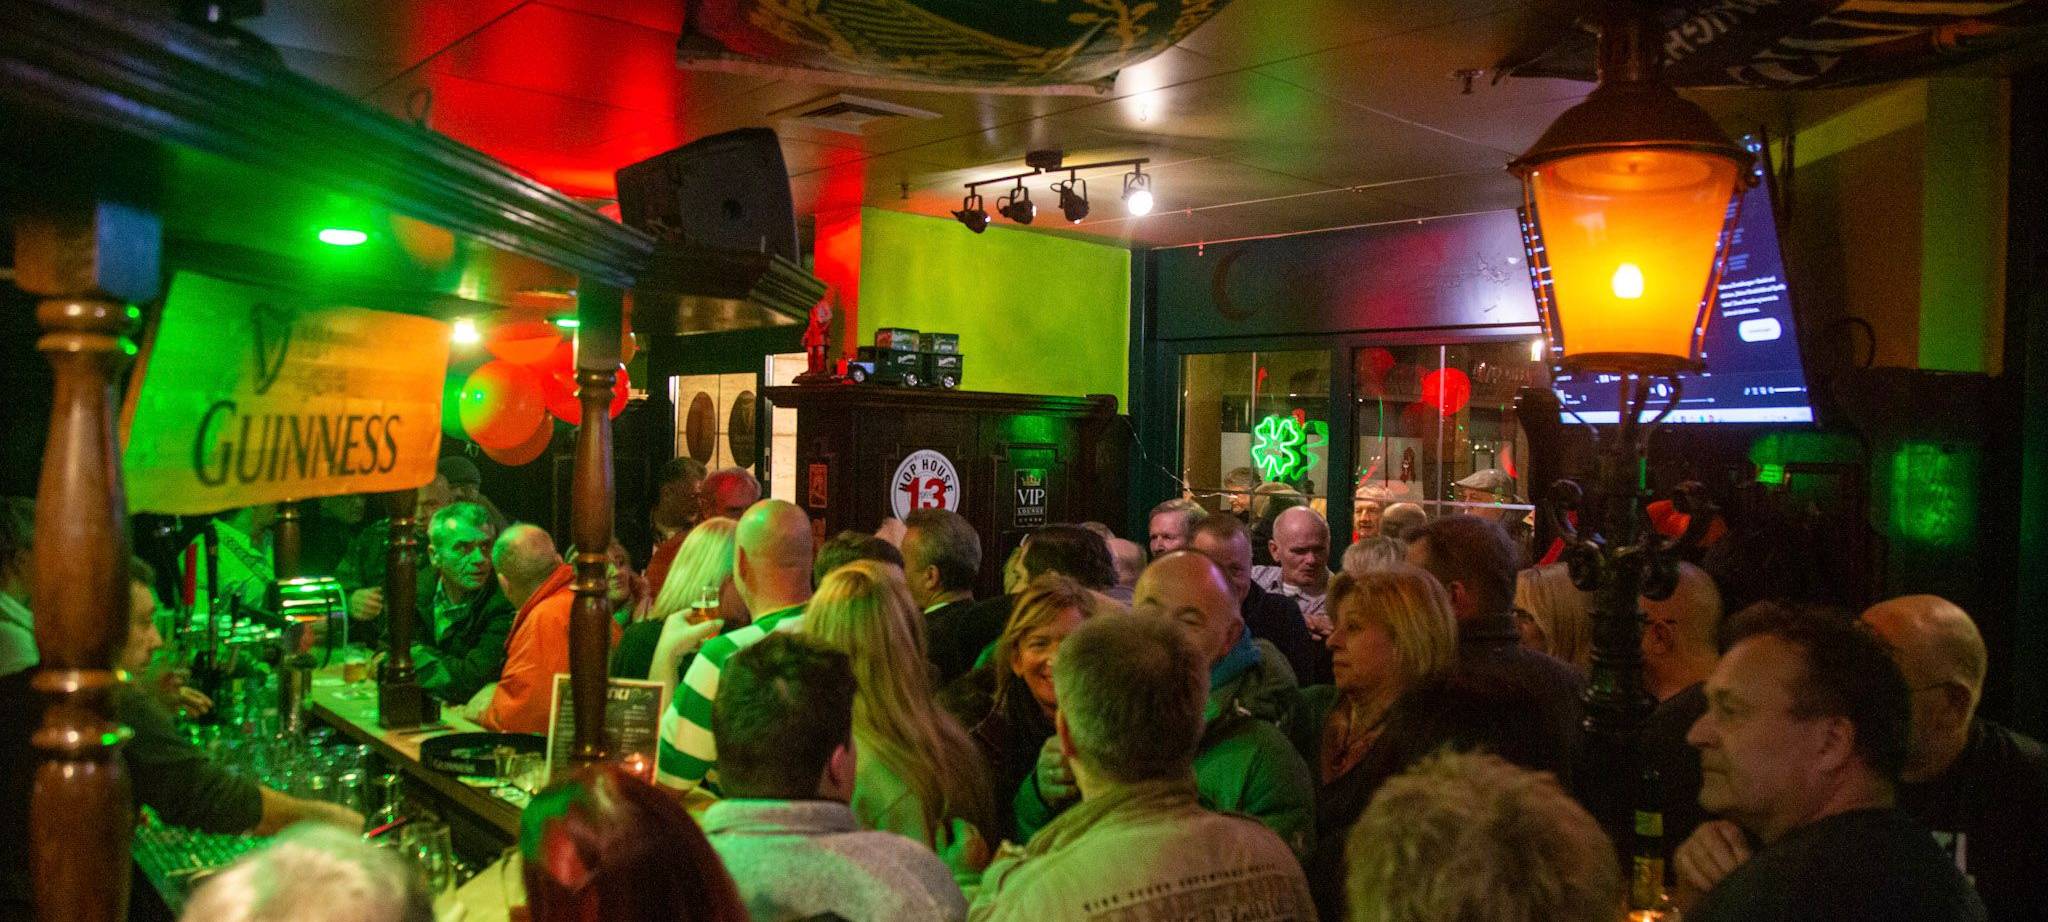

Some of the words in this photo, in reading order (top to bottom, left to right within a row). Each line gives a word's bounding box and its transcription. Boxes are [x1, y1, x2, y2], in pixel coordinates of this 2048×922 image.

[194, 400, 400, 487] GUINNESS
[898, 463, 917, 492] HOP
[922, 459, 954, 492] HOUSE
[907, 478, 946, 511] 13
[1017, 488, 1046, 505] VIP
